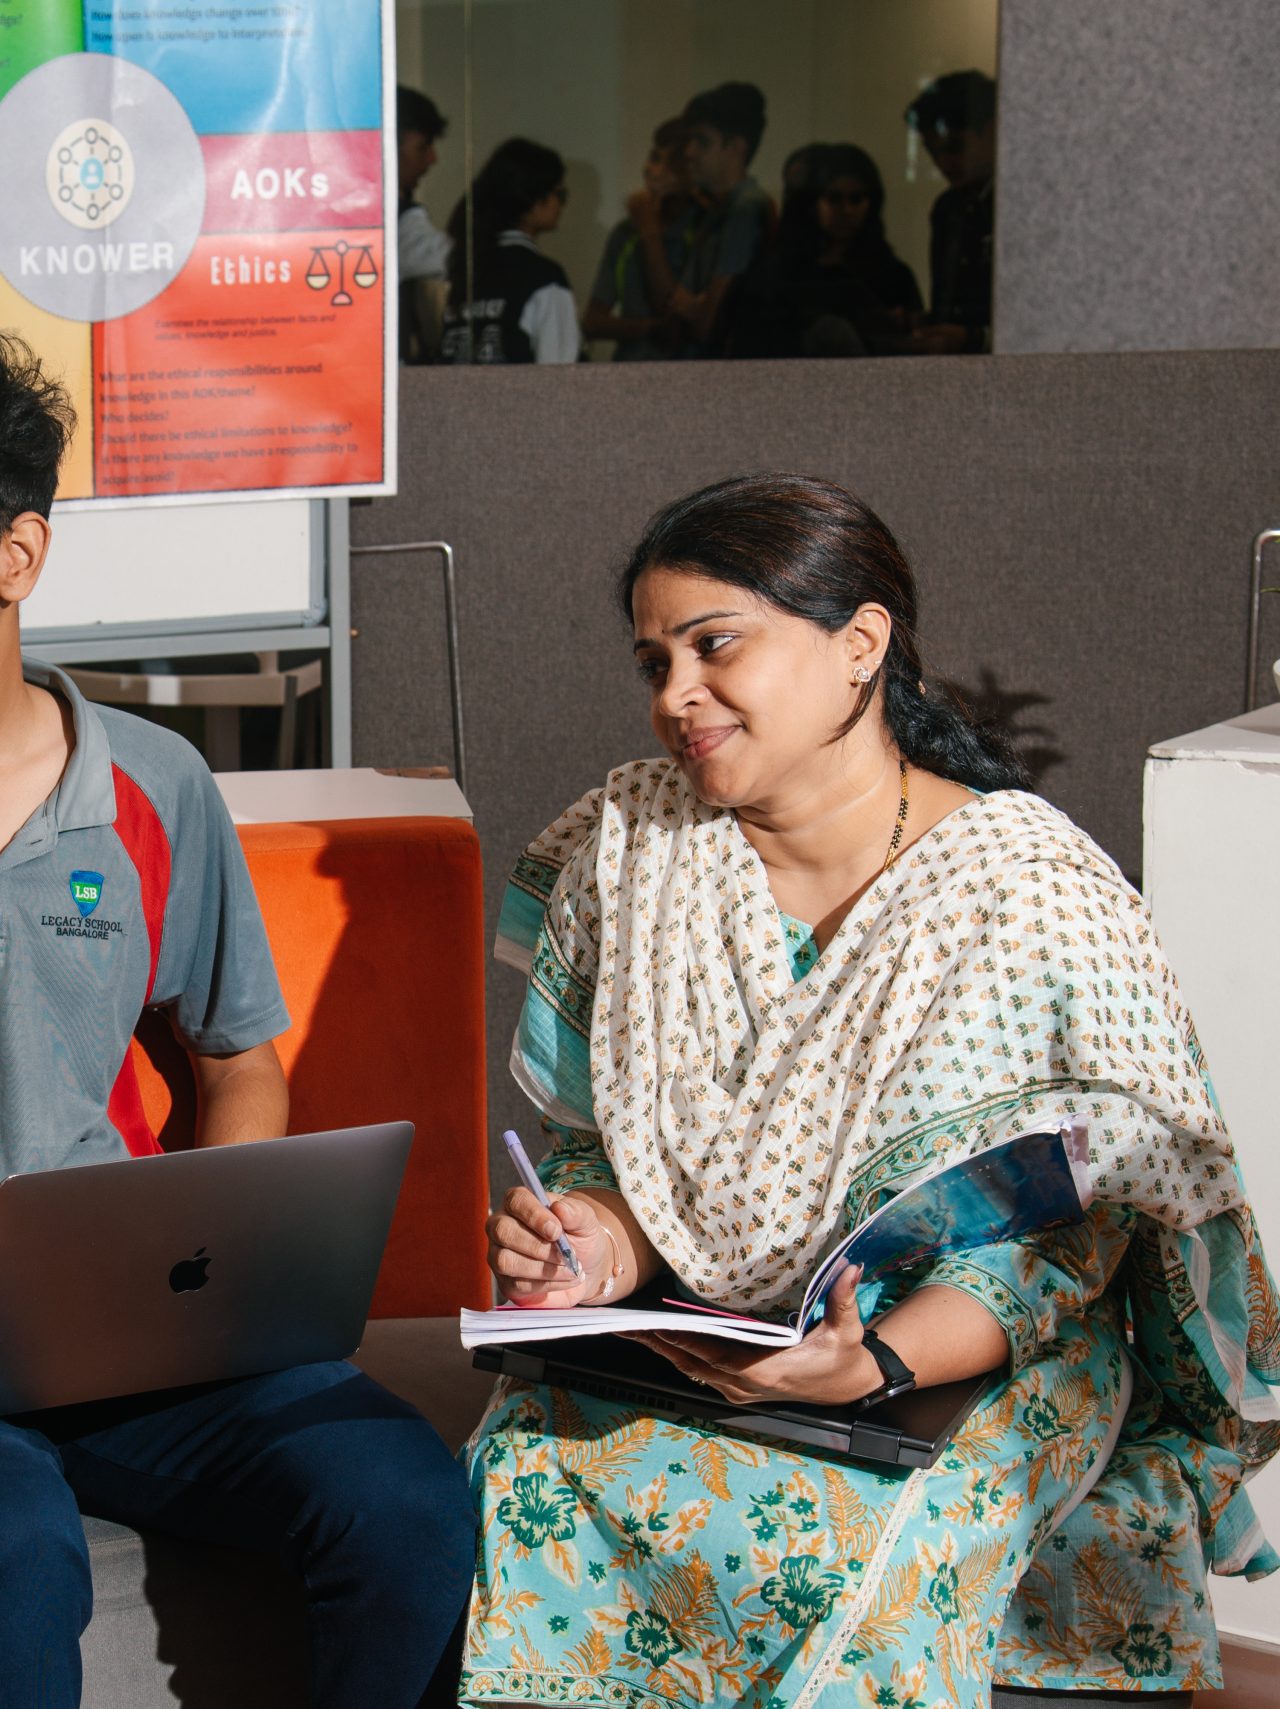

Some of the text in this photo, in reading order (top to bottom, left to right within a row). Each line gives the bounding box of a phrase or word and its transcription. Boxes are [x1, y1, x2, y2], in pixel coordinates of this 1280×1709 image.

[231, 167, 330, 200] AOKs
[19, 241, 174, 276] KNOWER
[210, 255, 292, 285] Ethics
[75, 885, 98, 899] LSB
[41, 915, 123, 933] LEGACY SCHOOL
[56, 927, 109, 940] BANGALORE
